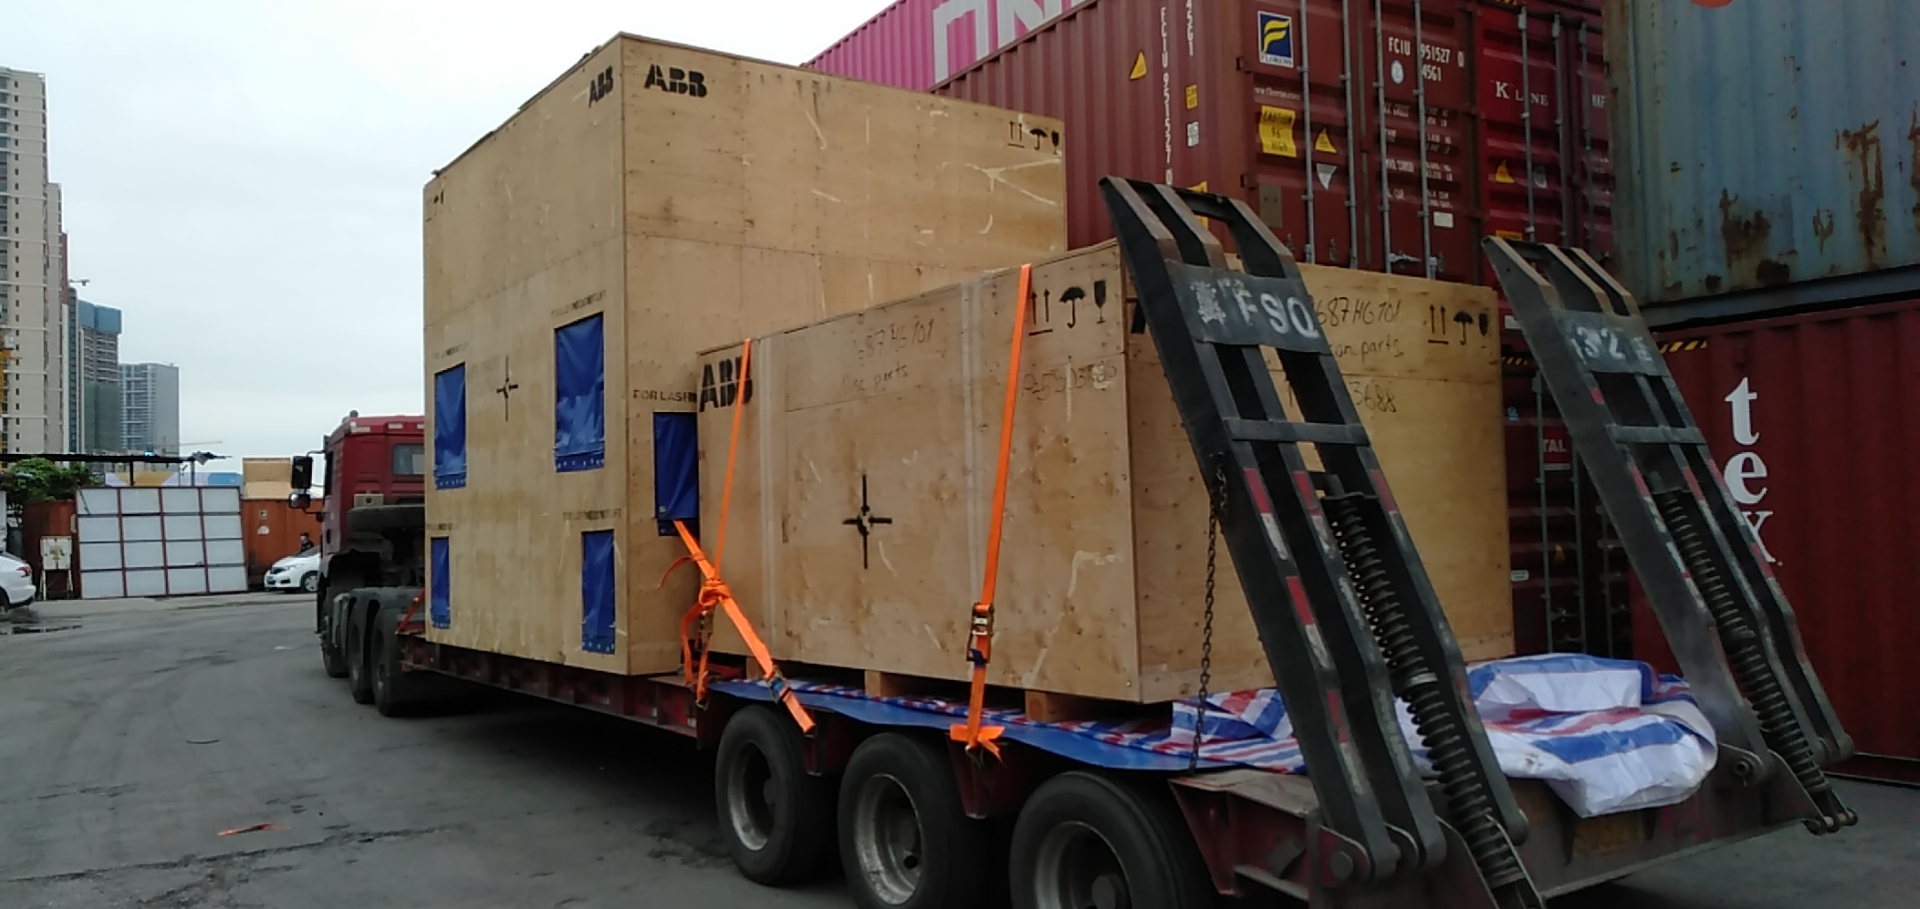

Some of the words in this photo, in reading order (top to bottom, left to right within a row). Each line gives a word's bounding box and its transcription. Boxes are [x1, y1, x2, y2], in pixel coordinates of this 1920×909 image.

[1387, 36, 1411, 56] FCIU
[1420, 43, 1451, 64] 951527
[589, 65, 614, 108] ABB
[643, 63, 708, 98] ABB
[1514, 89, 1549, 107] LNE
[633, 389, 657, 401] FOR
[698, 356, 753, 412] ABB
